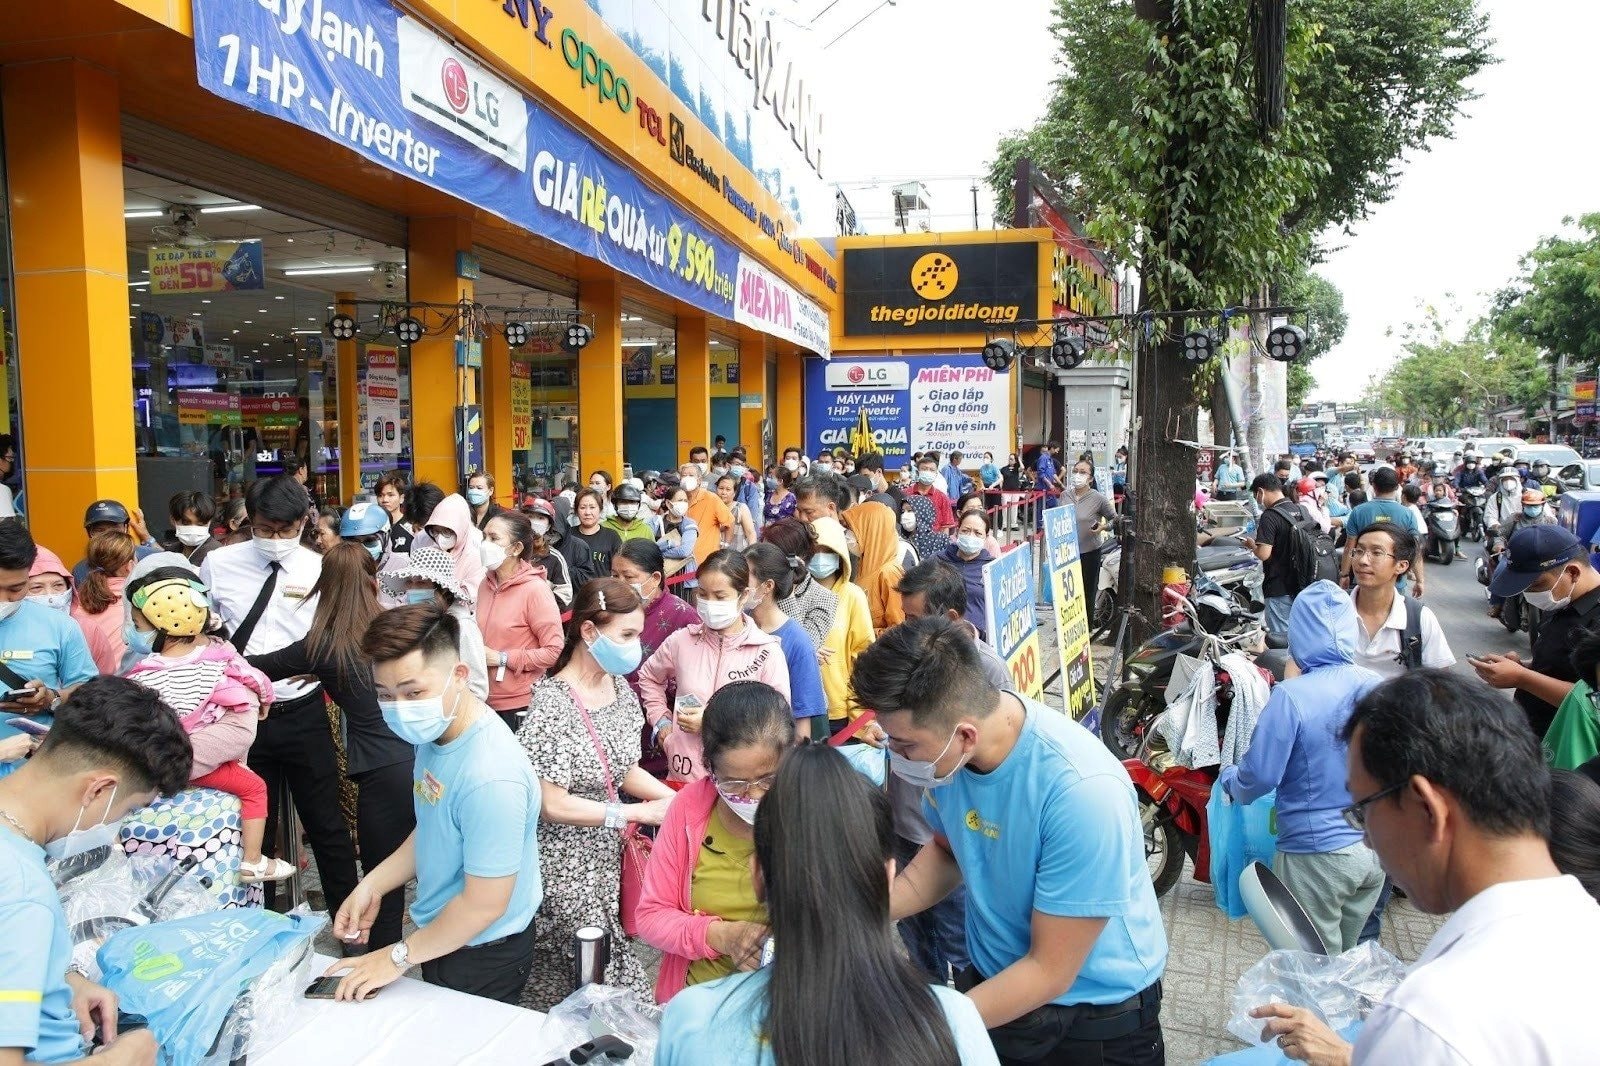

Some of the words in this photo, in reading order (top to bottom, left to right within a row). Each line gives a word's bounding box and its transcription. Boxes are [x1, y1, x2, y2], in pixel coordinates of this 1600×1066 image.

[219, 34, 240, 86] 1
[247, 46, 305, 108] HP
[329, 89, 441, 178] Inverter
[472, 81, 499, 127] LG
[637, 97, 666, 146] TCL
[667, 221, 715, 292] 9.590
[870, 303, 1019, 326] thegioididong
[868, 368, 887, 381] LG
[836, 392, 861, 405] MÁY
[862, 394, 894, 406] LẠNH
[928, 389, 960, 400] Giao
[962, 387, 984, 401] lắp
[833, 406, 850, 416] HP
[932, 401, 956, 414] Ống
[819, 426, 848, 445] GIÁ
[873, 426, 908, 445] QUÁ
[925, 422, 933, 432] 2
[934, 420, 952, 432] lần
[955, 420, 968, 433] vệ
[970, 420, 996, 431] sinh
[926, 440, 956, 453] T.Góp
[1061, 568, 1075, 602] 50
[727, 648, 770, 681] Christian
[672, 754, 692, 776] CD
